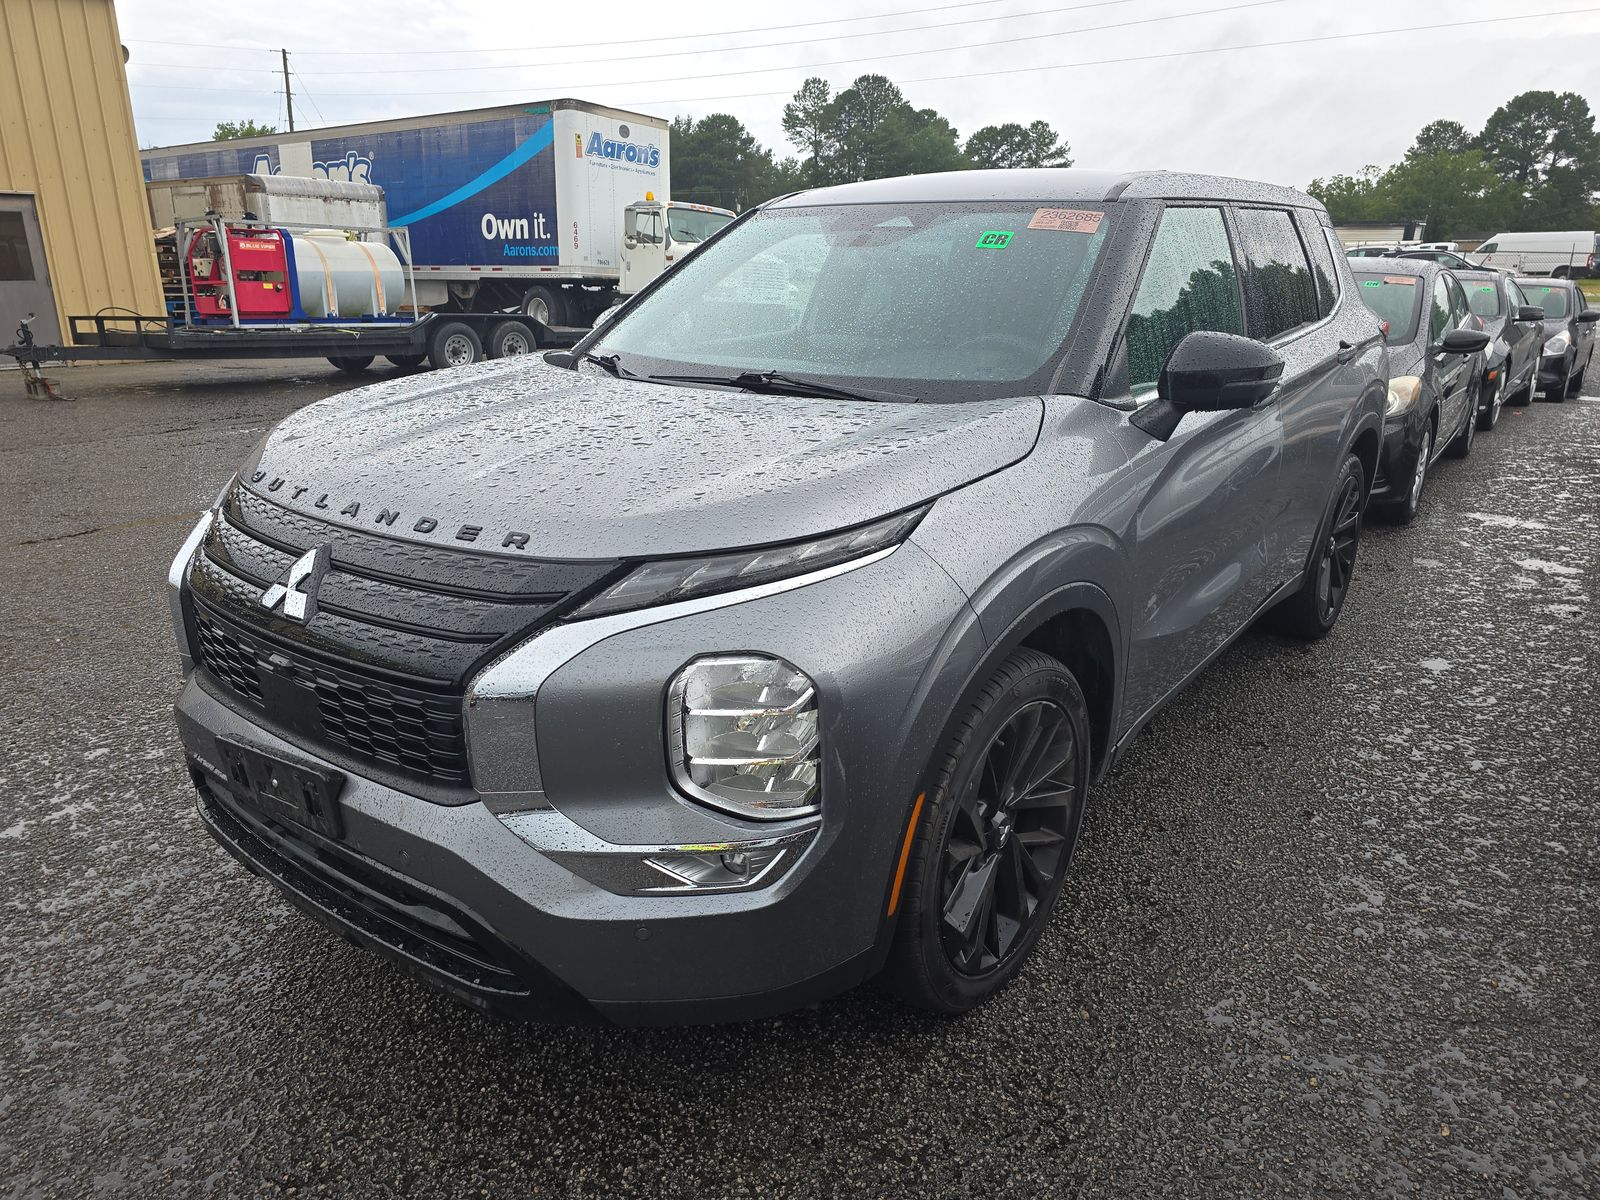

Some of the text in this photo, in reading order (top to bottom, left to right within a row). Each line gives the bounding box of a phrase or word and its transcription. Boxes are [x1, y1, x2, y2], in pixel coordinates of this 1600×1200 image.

[585, 131, 660, 168] Aaron's
[481, 212, 551, 240] Own it.
[1040, 210, 1102, 222] 2362685
[981, 233, 1009, 246] CR
[503, 244, 559, 256] Aarons.com
[251, 471, 531, 550] OUTLANDER
